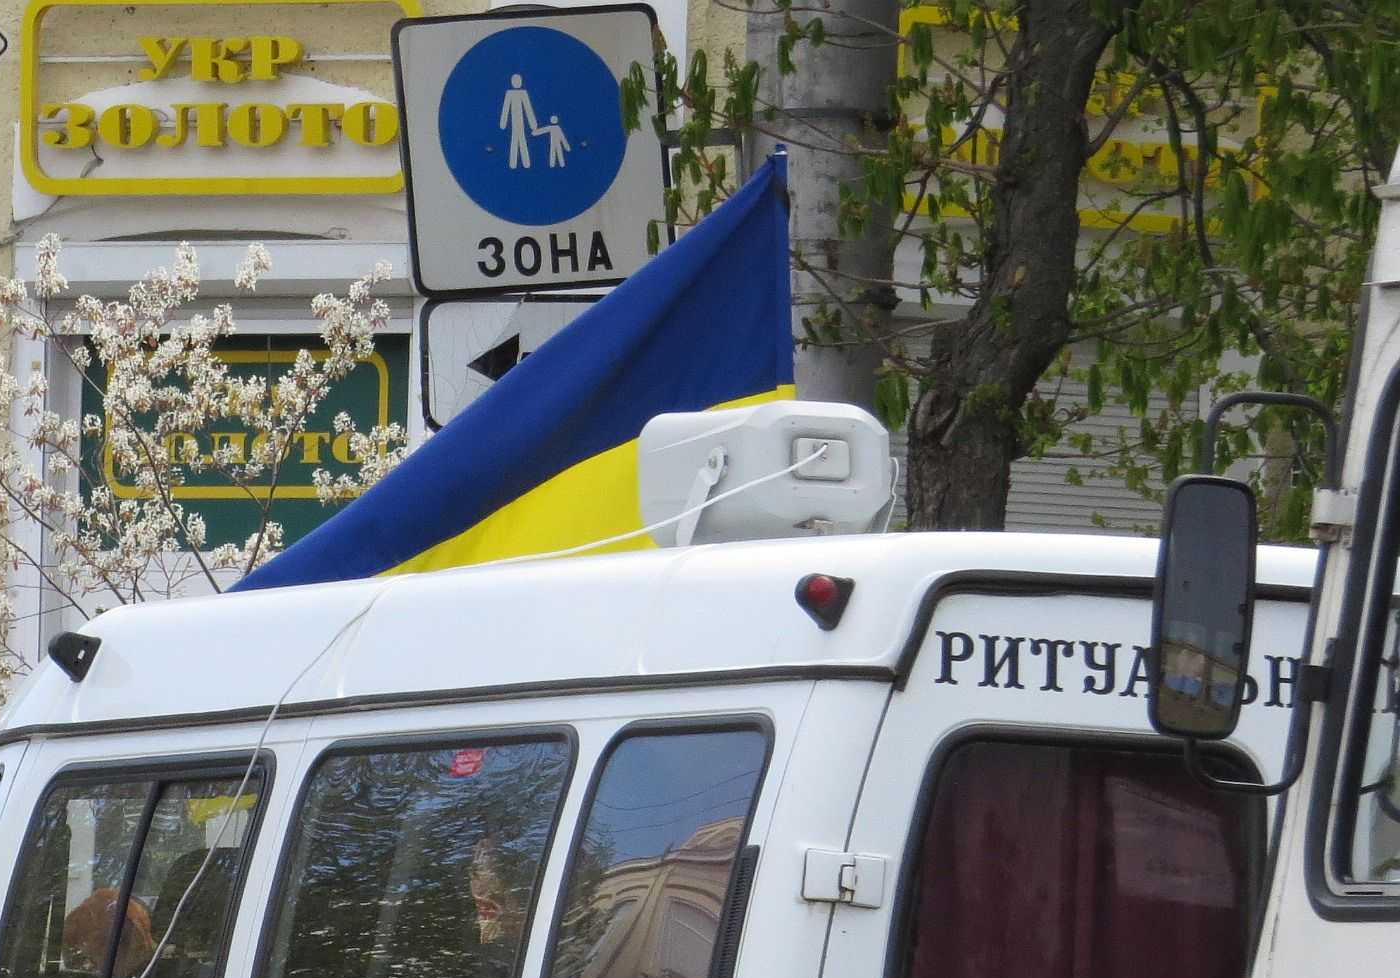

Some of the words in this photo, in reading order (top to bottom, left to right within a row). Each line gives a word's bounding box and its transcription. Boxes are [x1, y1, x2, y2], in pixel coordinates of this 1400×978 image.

[137, 35, 304, 84] УКР
[41, 101, 399, 148] ЗОЛОТО
[477, 230, 613, 278] ЗОНА
